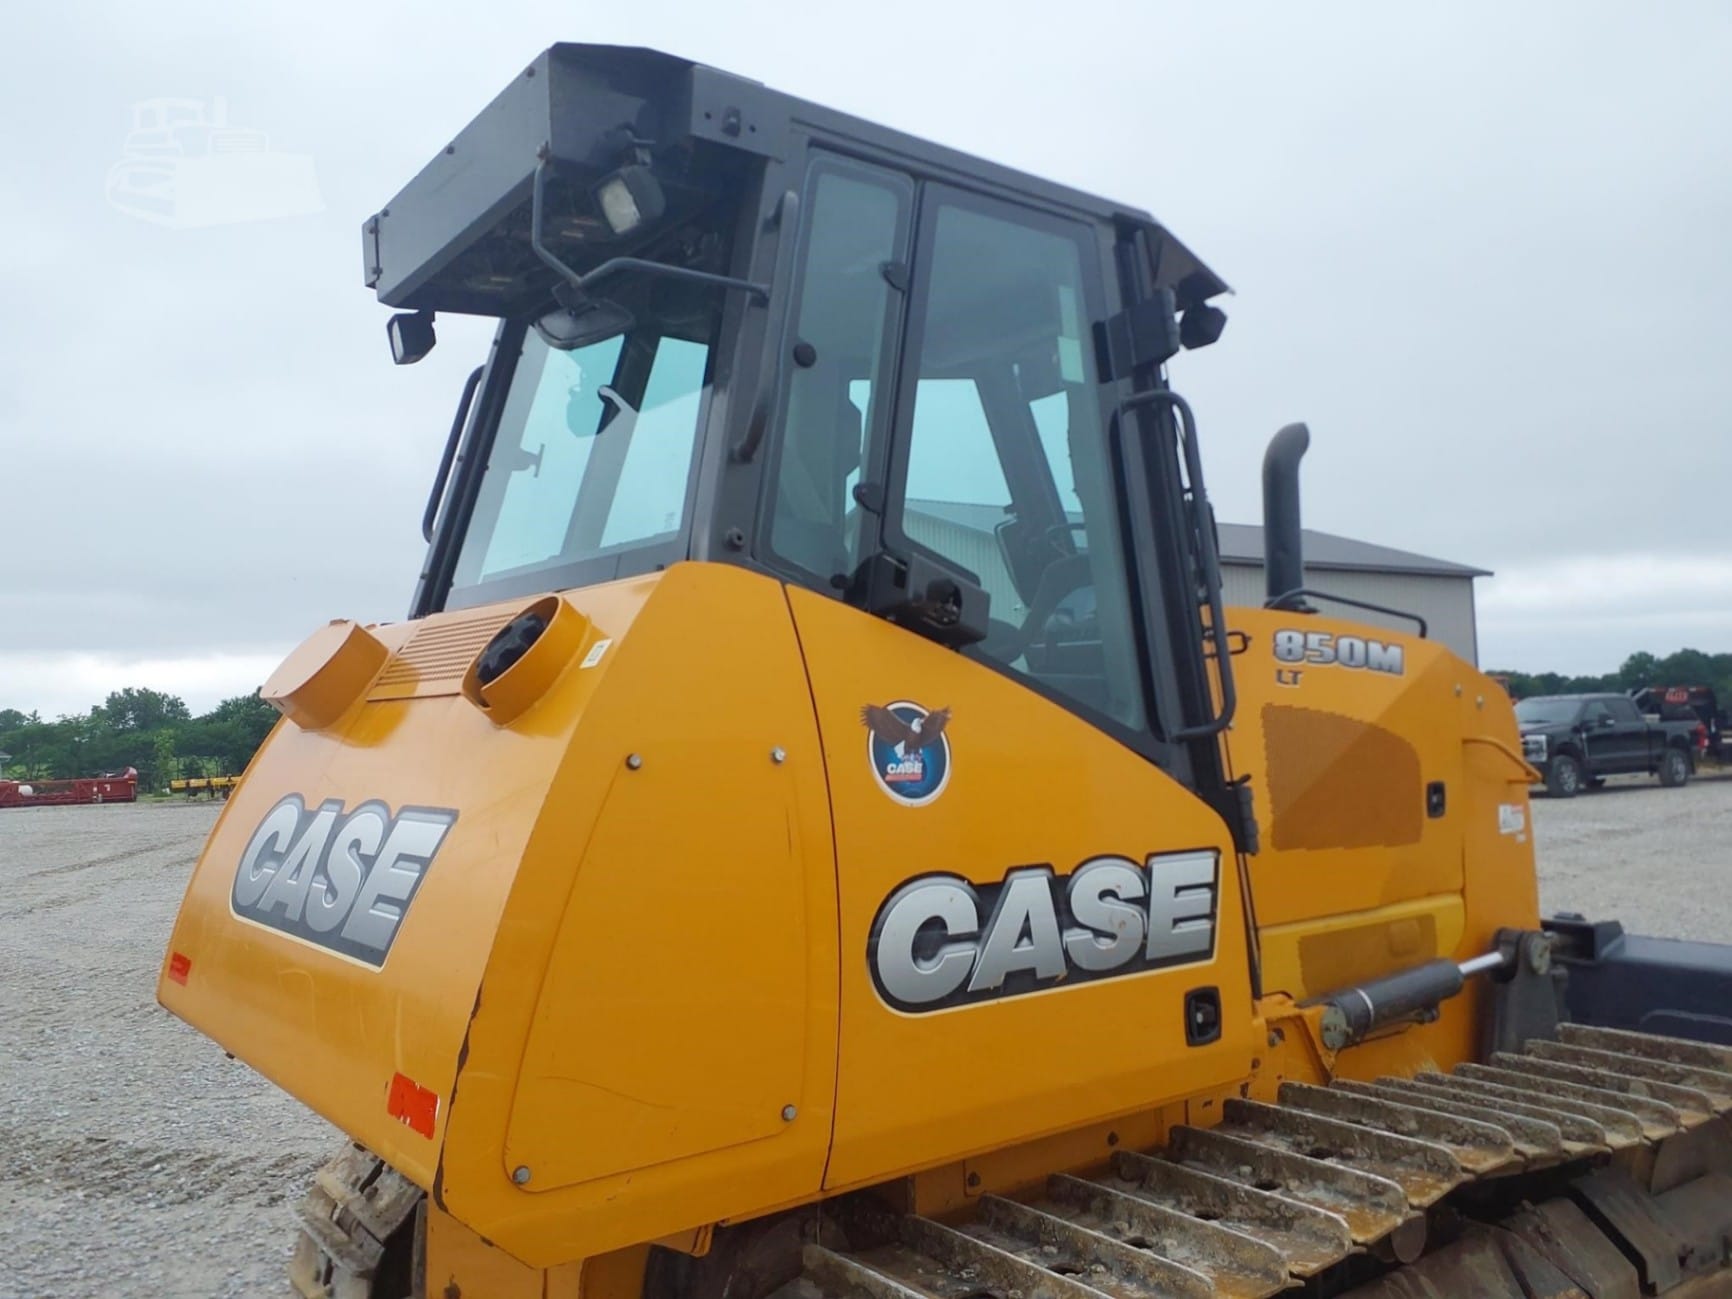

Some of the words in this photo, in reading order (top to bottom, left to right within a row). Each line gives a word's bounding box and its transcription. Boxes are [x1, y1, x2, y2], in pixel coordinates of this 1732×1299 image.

[1274, 628, 1404, 675] 850M
[1275, 668, 1303, 685] LT
[886, 762, 923, 775] CASE
[234, 795, 457, 951] CASE
[874, 849, 1219, 1006] CASE
